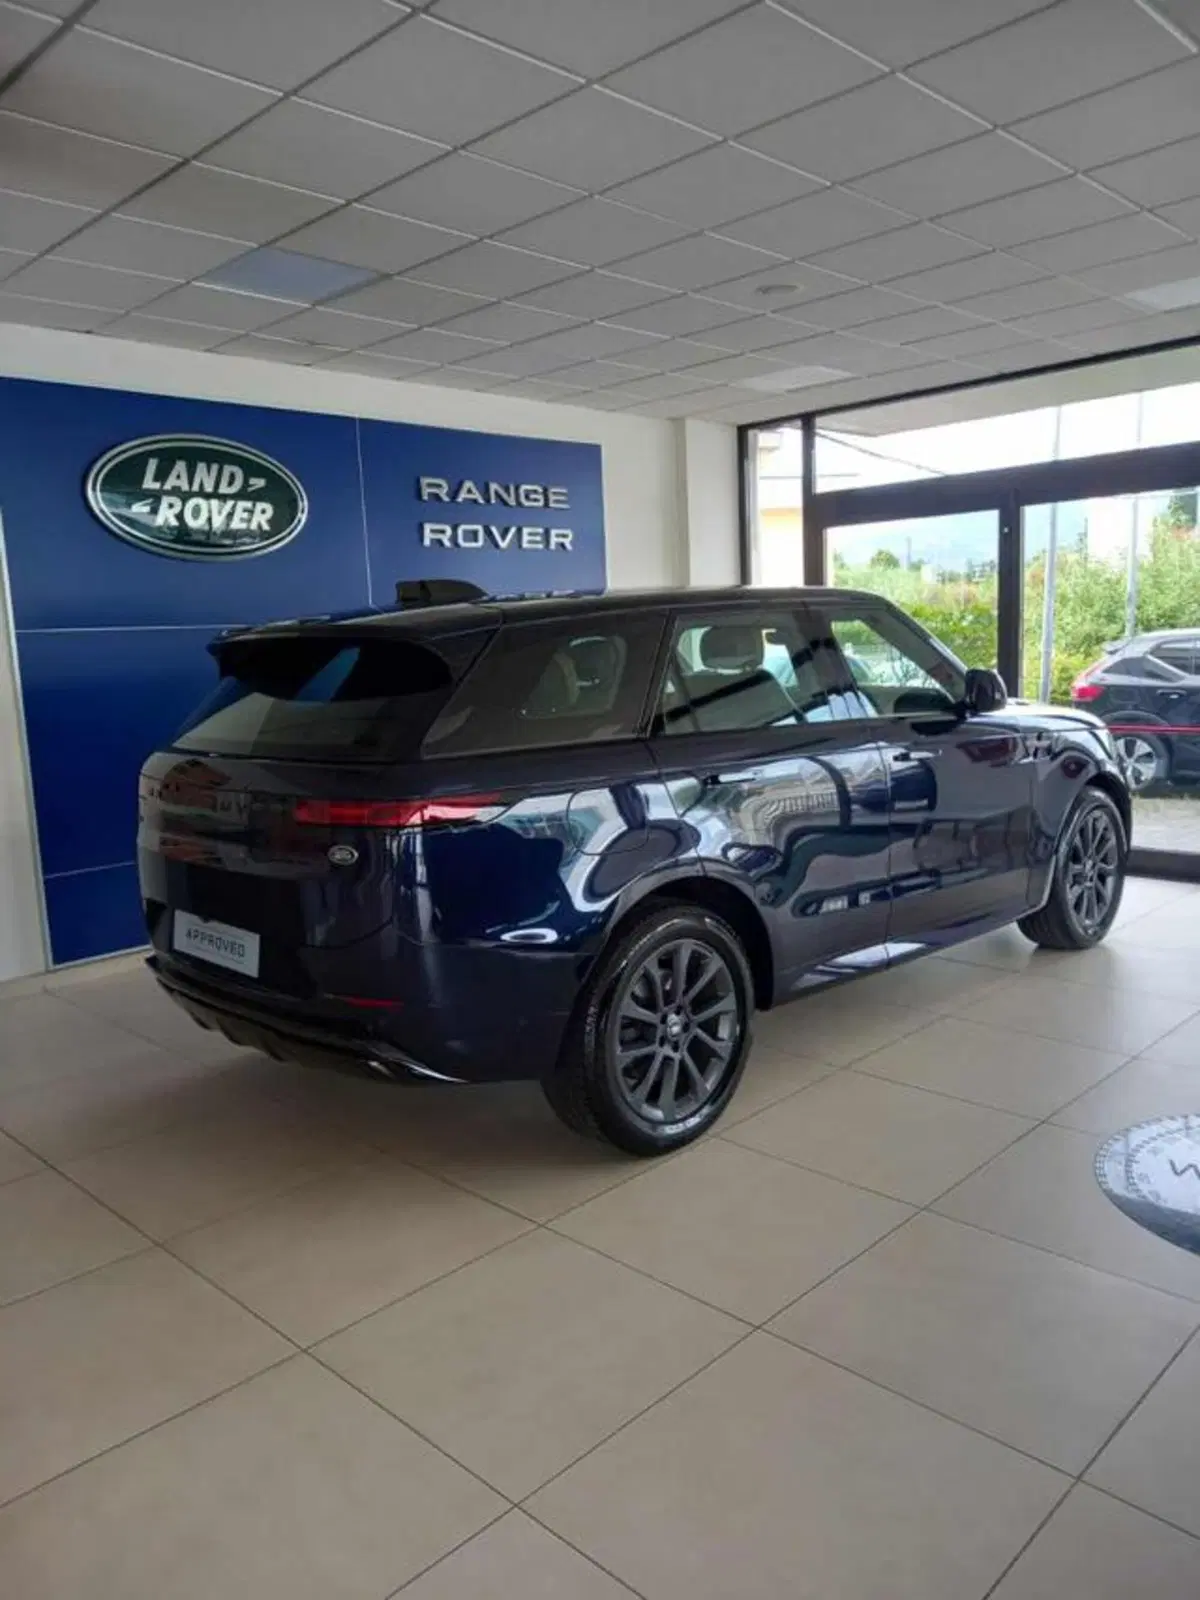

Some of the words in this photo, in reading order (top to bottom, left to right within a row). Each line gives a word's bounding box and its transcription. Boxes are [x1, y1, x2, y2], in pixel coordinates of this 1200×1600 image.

[141, 457, 244, 495] LAND
[419, 475, 570, 509] RANGE
[154, 495, 274, 532] ROVER
[422, 522, 573, 551] ROVER
[185, 927, 246, 958] APPROVED
